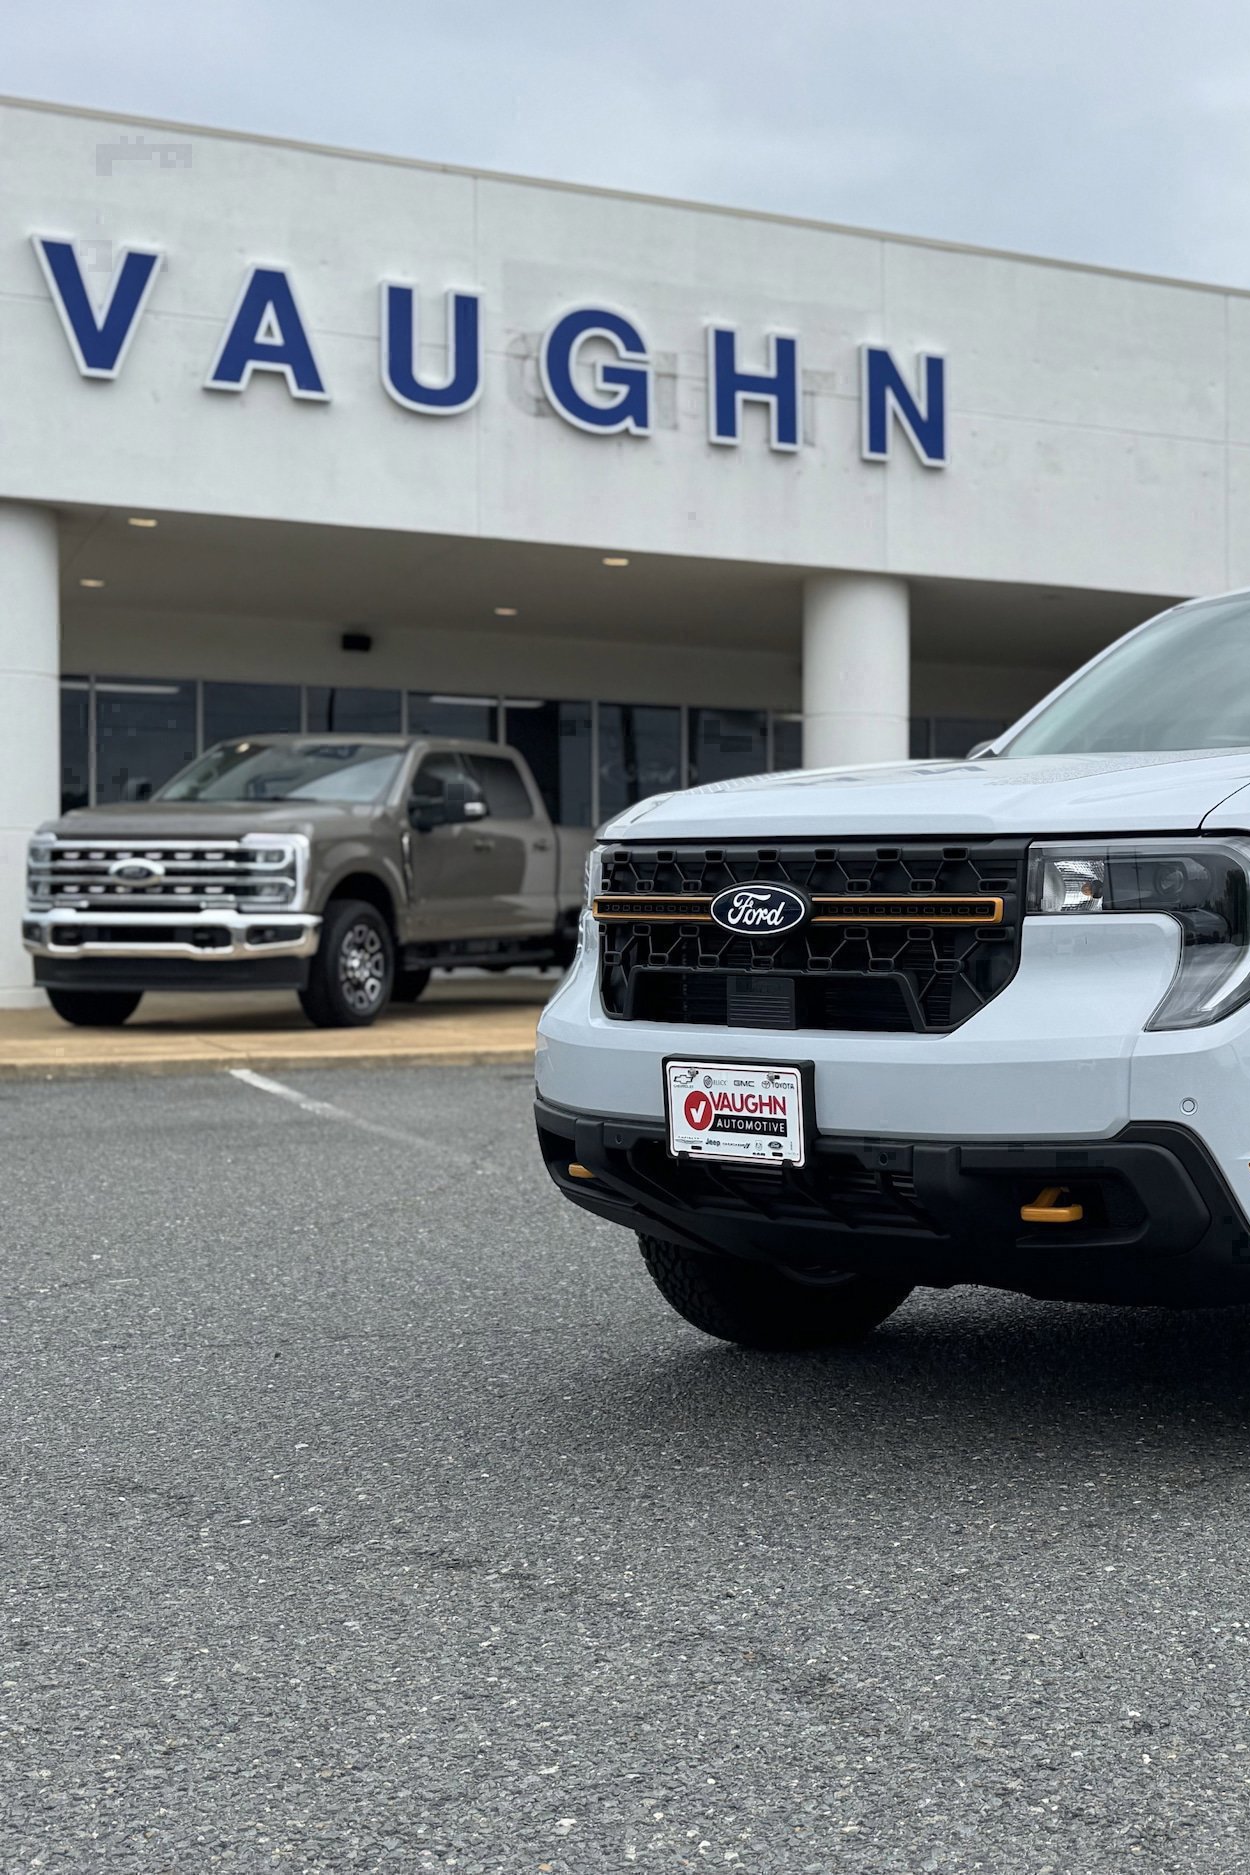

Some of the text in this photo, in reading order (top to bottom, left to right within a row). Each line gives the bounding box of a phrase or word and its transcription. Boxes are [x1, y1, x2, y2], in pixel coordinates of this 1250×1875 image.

[31, 234, 947, 468] VAUGHN
[727, 892, 785, 926] Ford
[734, 1080, 755, 1088] GMC
[772, 1081, 795, 1090] TOYOTA
[709, 1091, 787, 1116] VAUGHN
[716, 1118, 785, 1133] AUTOMOTIVE
[705, 1138, 721, 1147] Jeep
